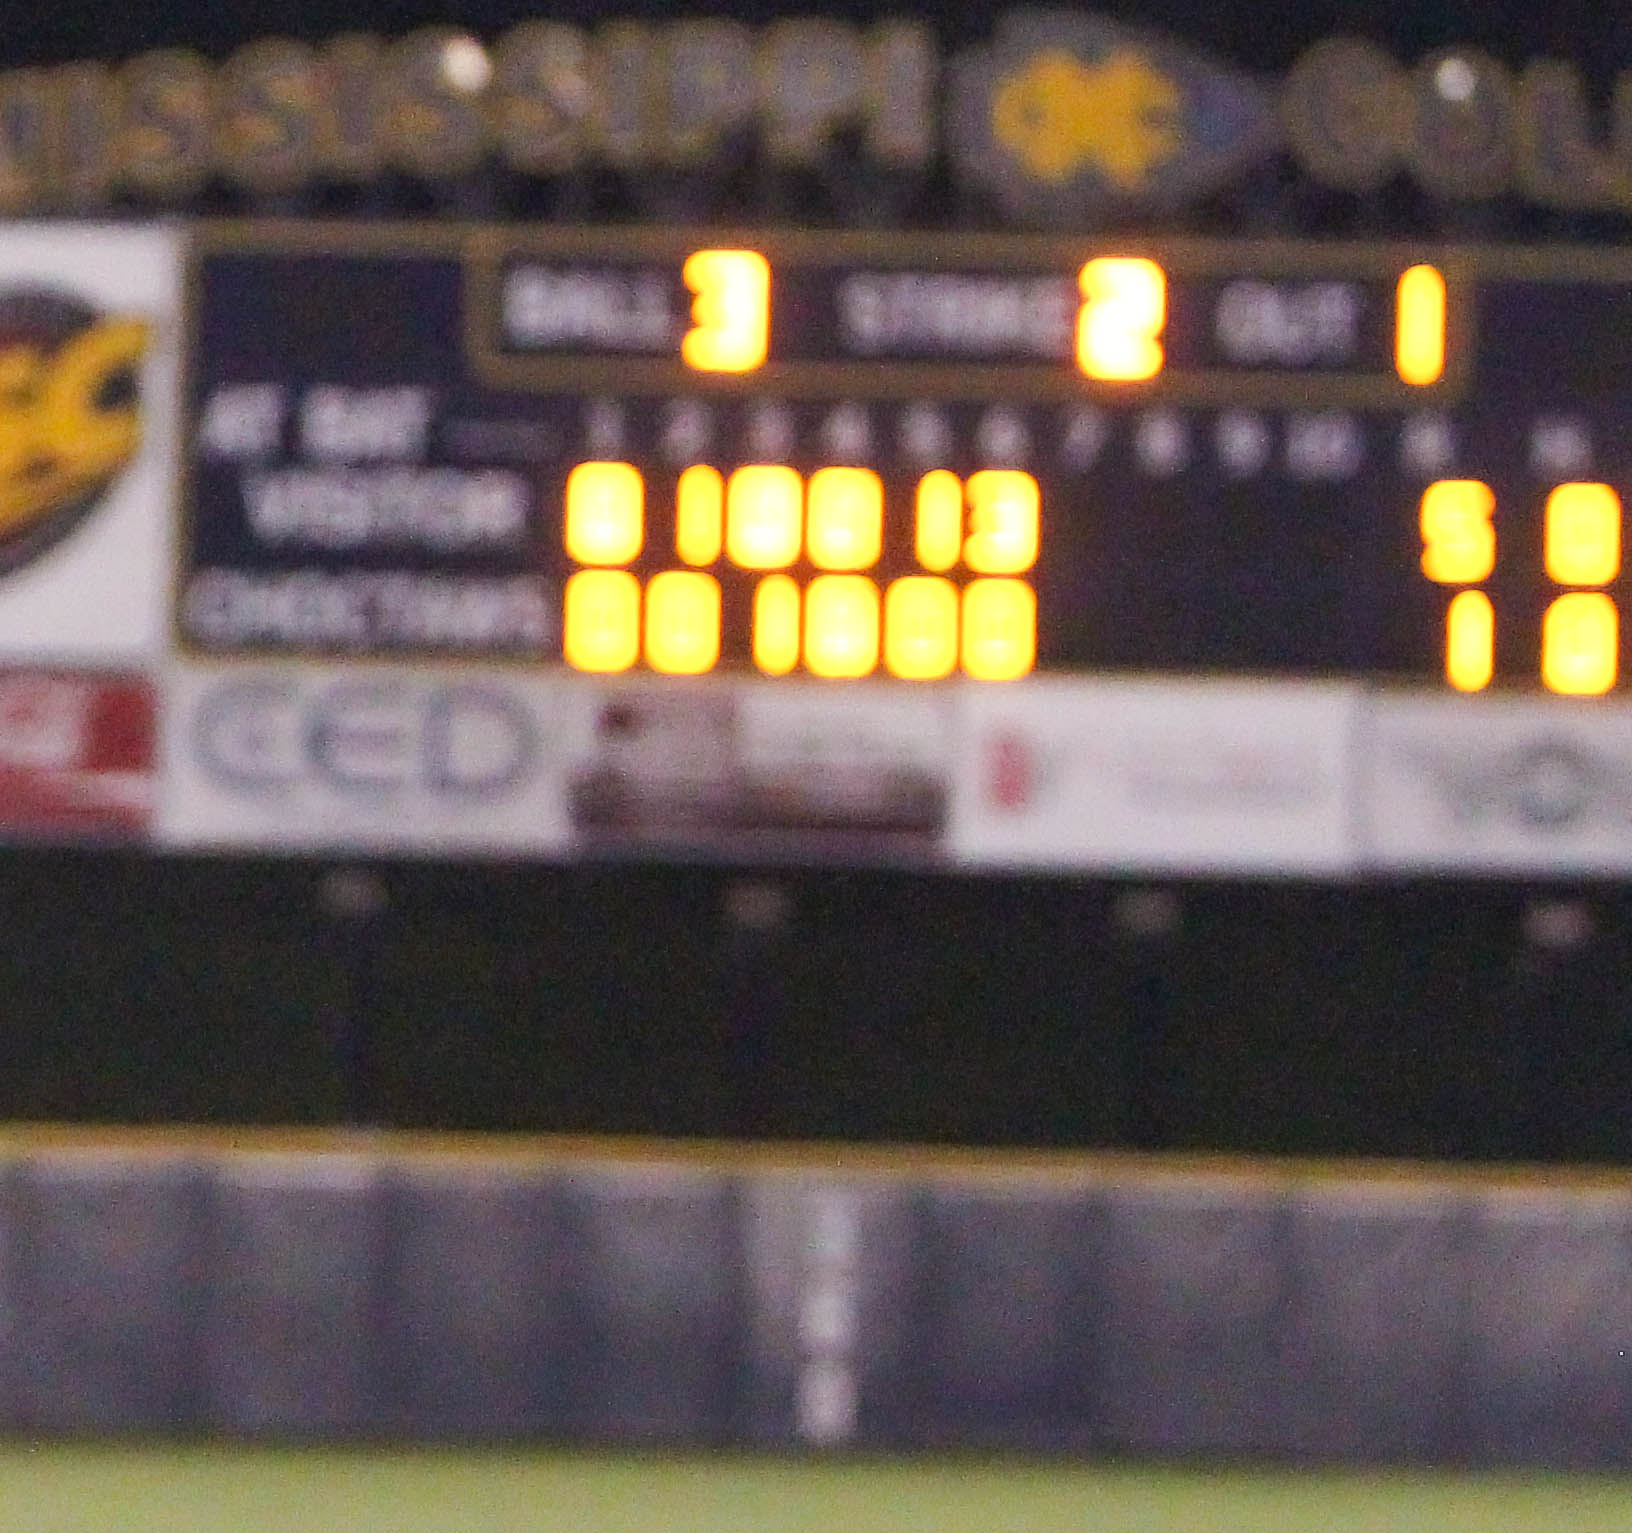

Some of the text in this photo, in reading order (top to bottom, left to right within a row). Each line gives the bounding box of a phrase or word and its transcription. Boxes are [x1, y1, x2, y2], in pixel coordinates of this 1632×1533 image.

[502, 264, 672, 352] BALL
[682, 249, 770, 375] 3
[1075, 257, 1166, 384] 2
[1216, 280, 1358, 364] OUT
[1397, 265, 1445, 385] 1
[241, 466, 530, 548] VISITOR
[964, 470, 1040, 574] 3
[1421, 480, 1495, 583] 5
[1447, 590, 1493, 693] 1
